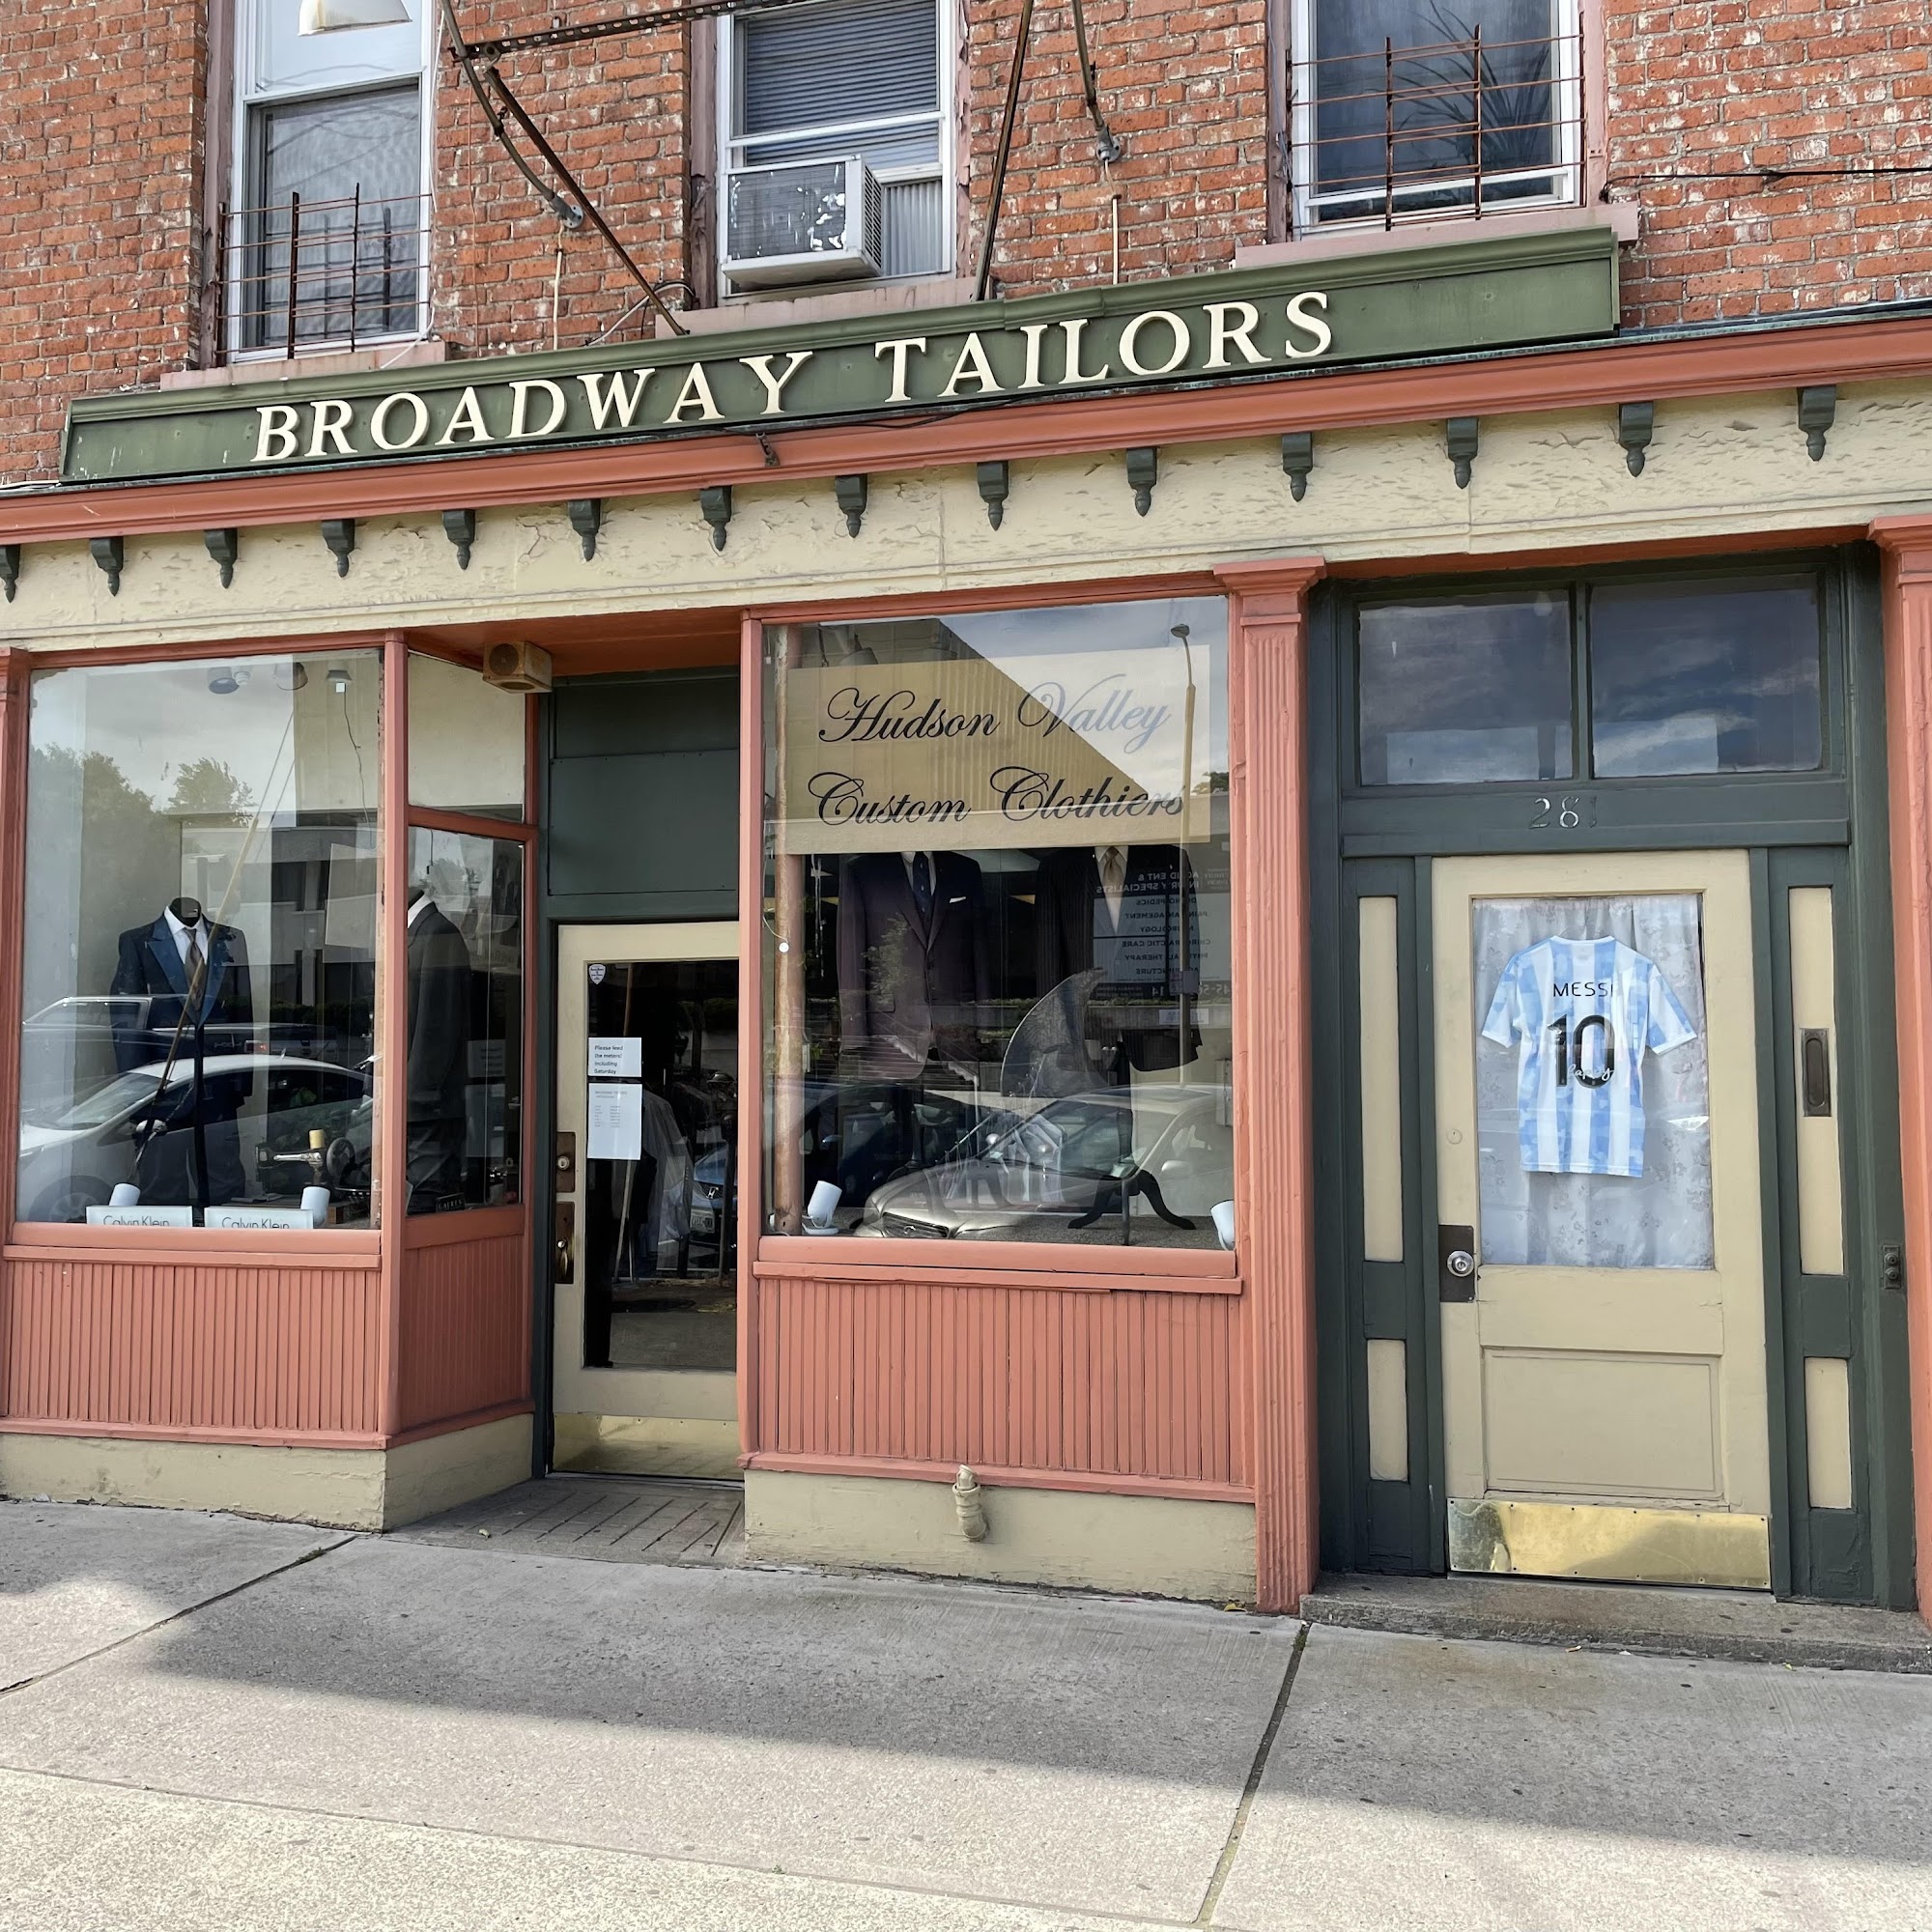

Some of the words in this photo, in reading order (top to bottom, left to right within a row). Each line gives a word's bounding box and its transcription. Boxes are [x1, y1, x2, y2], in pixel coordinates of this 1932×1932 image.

[250, 350, 813, 463] BROADWAY
[873, 291, 1333, 404] TAILORS
[818, 687, 1001, 743] Hudson
[1017, 673, 1173, 753] Valley
[808, 772, 973, 827] Custom
[989, 765, 1186, 822] Clothiers
[1552, 981, 1613, 997] MESSI
[1548, 1013, 1615, 1089] 10
[102, 1214, 139, 1226] Calvin
[141, 1215, 170, 1227] Klein
[221, 1216, 258, 1228] Calvin
[261, 1217, 290, 1229] Klein
